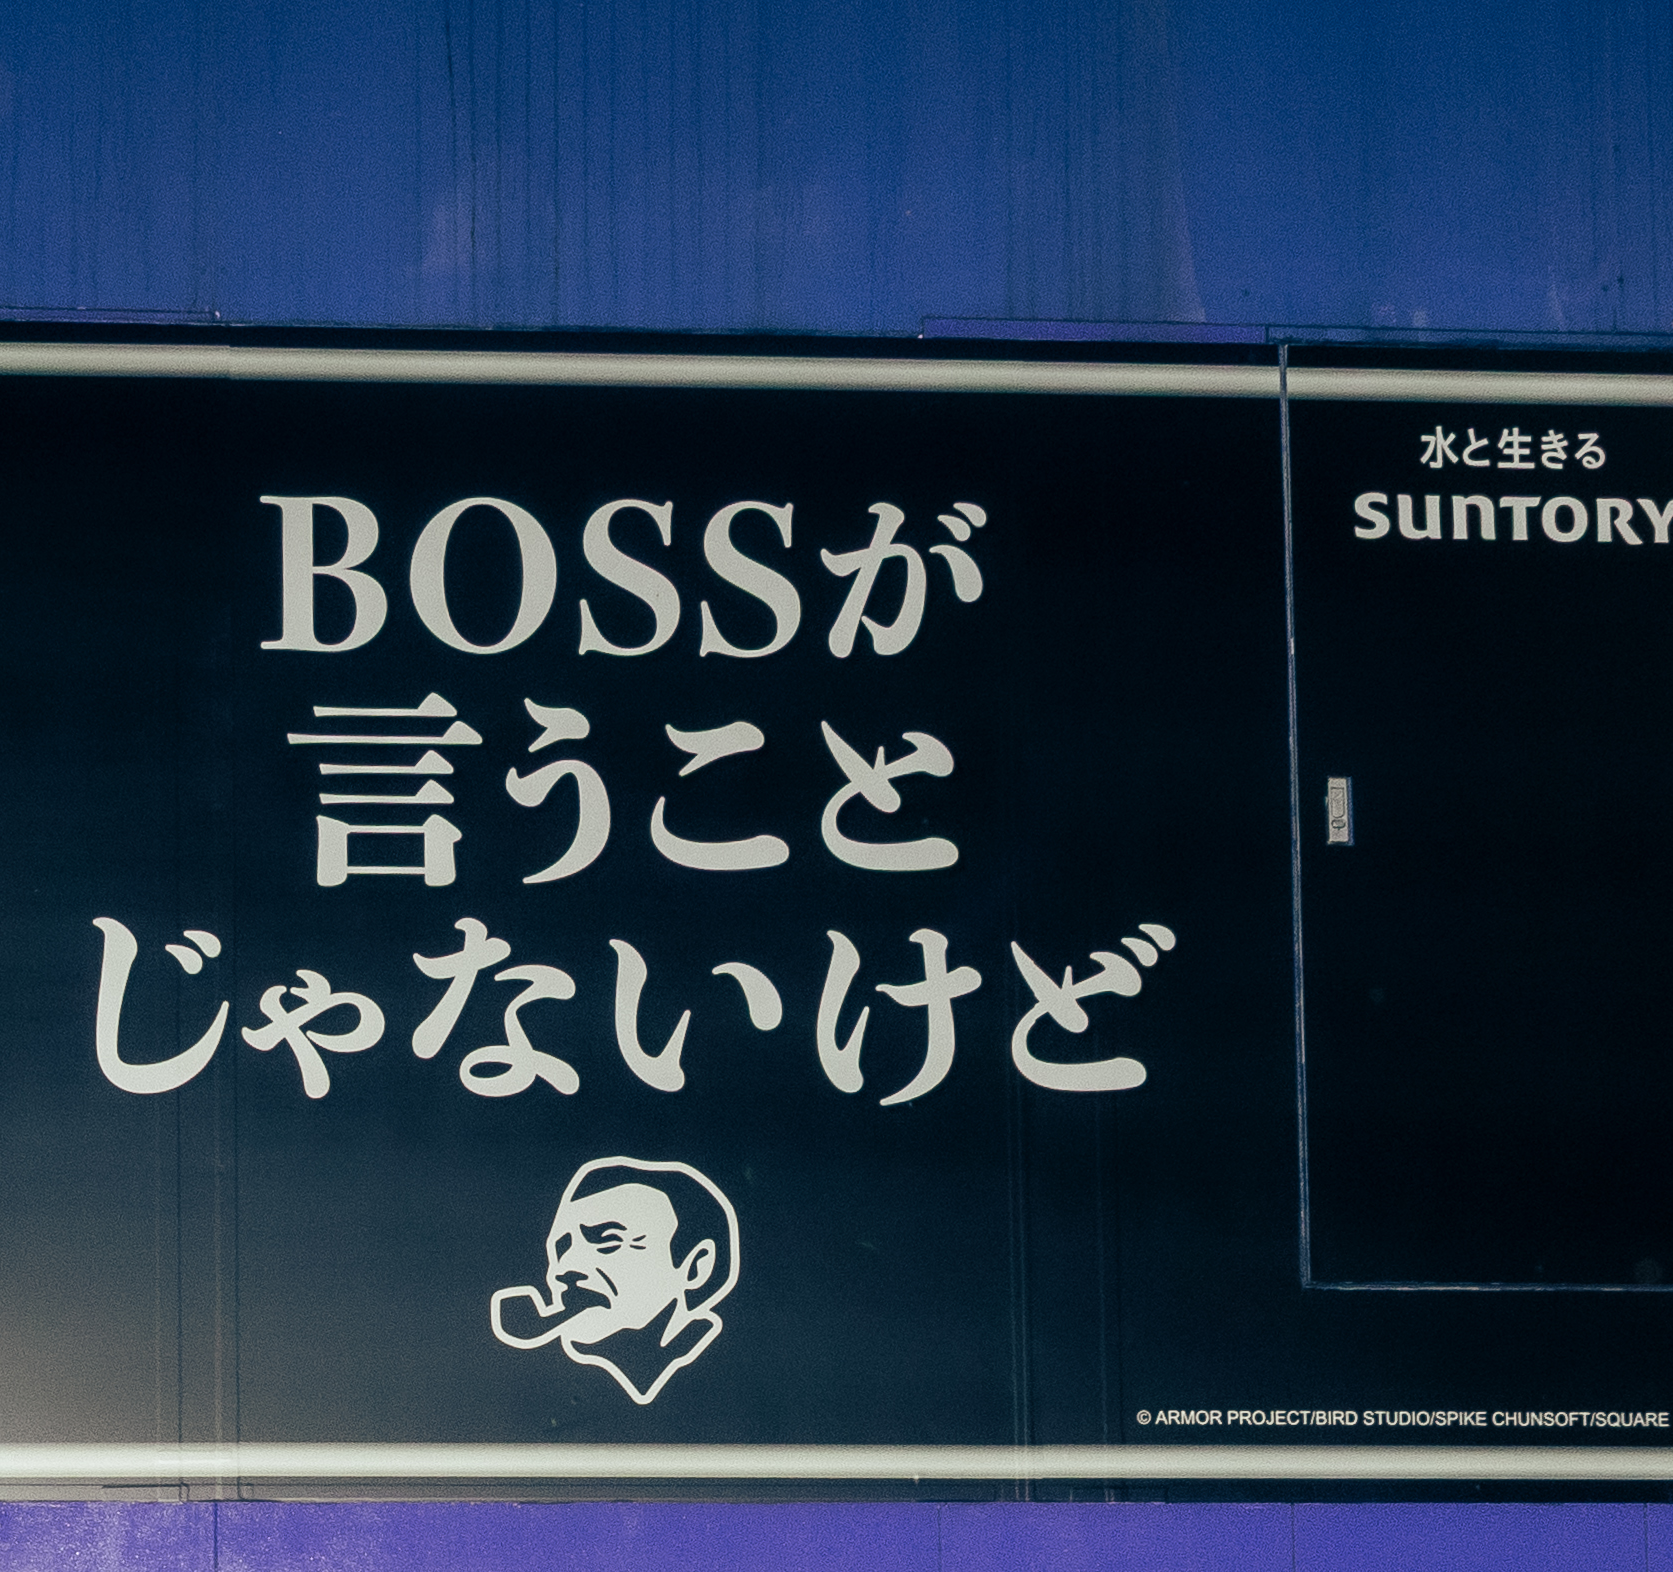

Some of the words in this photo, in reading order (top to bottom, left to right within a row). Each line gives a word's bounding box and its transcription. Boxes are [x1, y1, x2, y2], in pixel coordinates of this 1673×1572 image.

[1419, 425, 1607, 470] 水と生きる
[258, 494, 988, 660] BOSSが
[286, 691, 960, 888] 言うこと
[92, 916, 1177, 1107] じゃないけど
[1155, 1411, 1223, 1426] ARMOR
[1227, 1411, 1359, 1427] PROJECT/BIRD
[1363, 1411, 1488, 1428] STUDIO/SPIKE
[1492, 1411, 1670, 1429] CHUNSOFT/SQUARE
